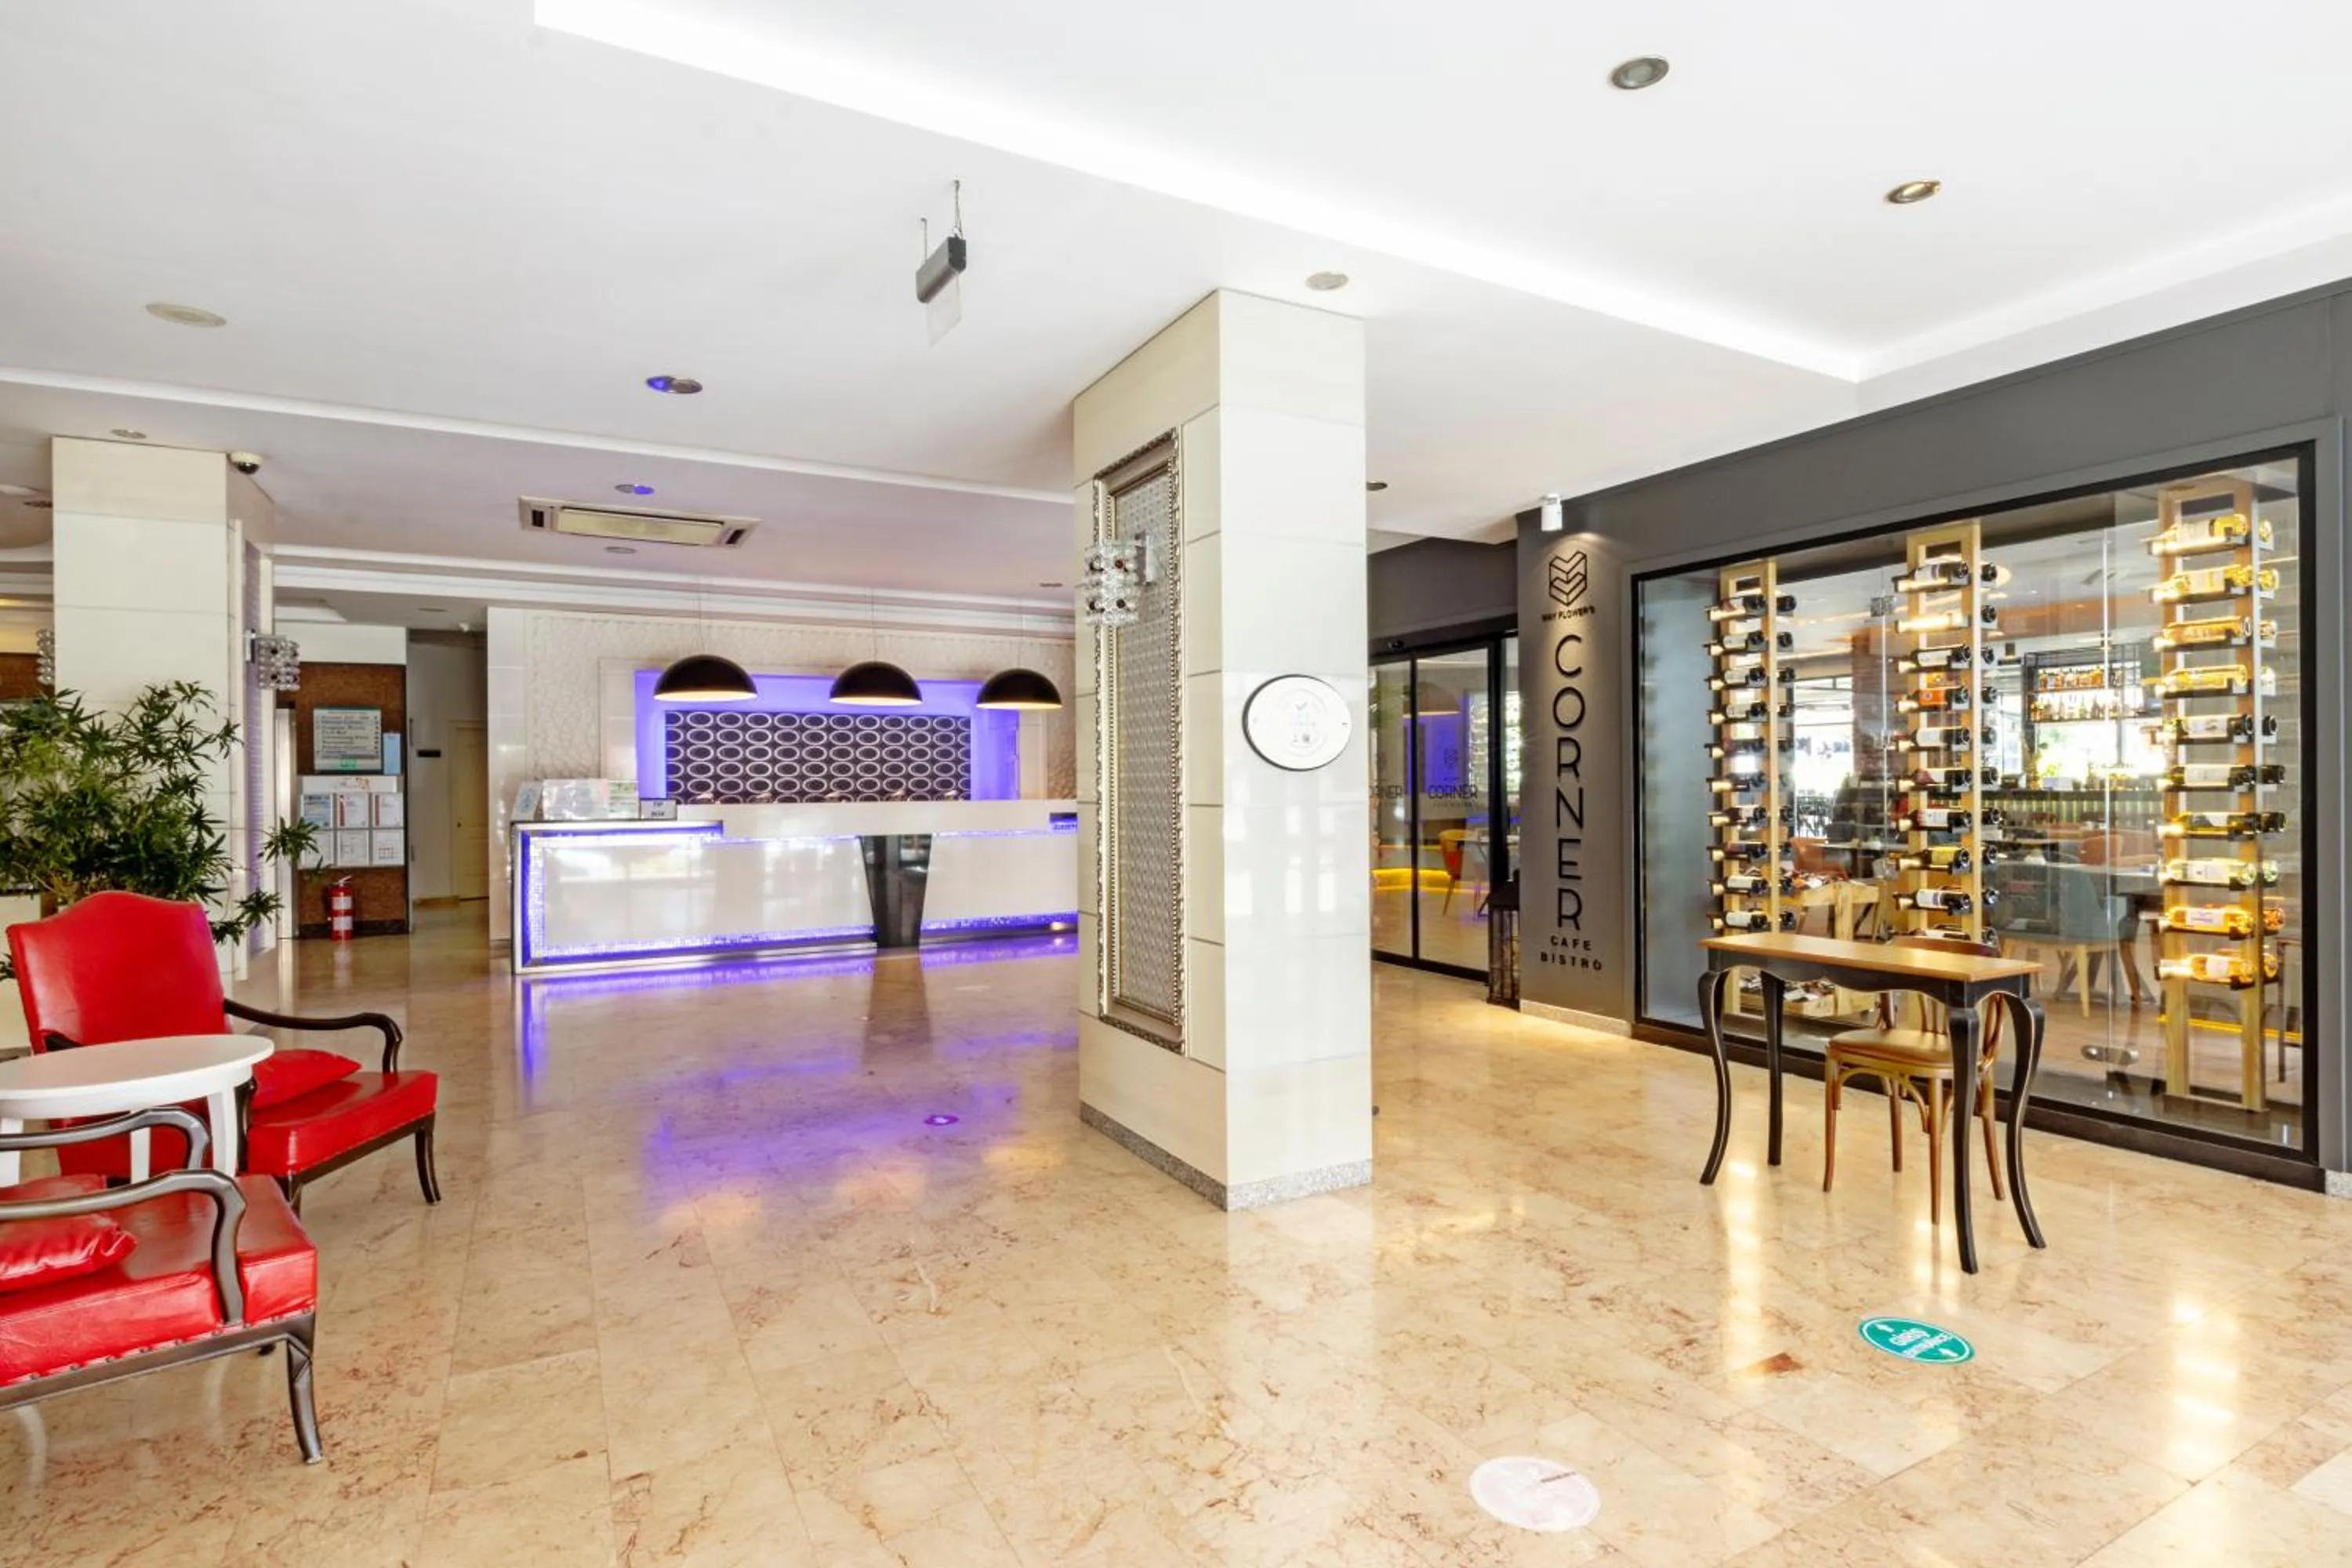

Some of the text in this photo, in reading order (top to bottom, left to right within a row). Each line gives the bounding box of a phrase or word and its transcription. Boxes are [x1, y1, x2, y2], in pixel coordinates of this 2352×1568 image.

[1428, 784, 1477, 799] CORNER
[1553, 634, 1585, 931] CORNER
[1551, 935, 1591, 951] CAFE
[1541, 951, 1602, 971] BISTRO
